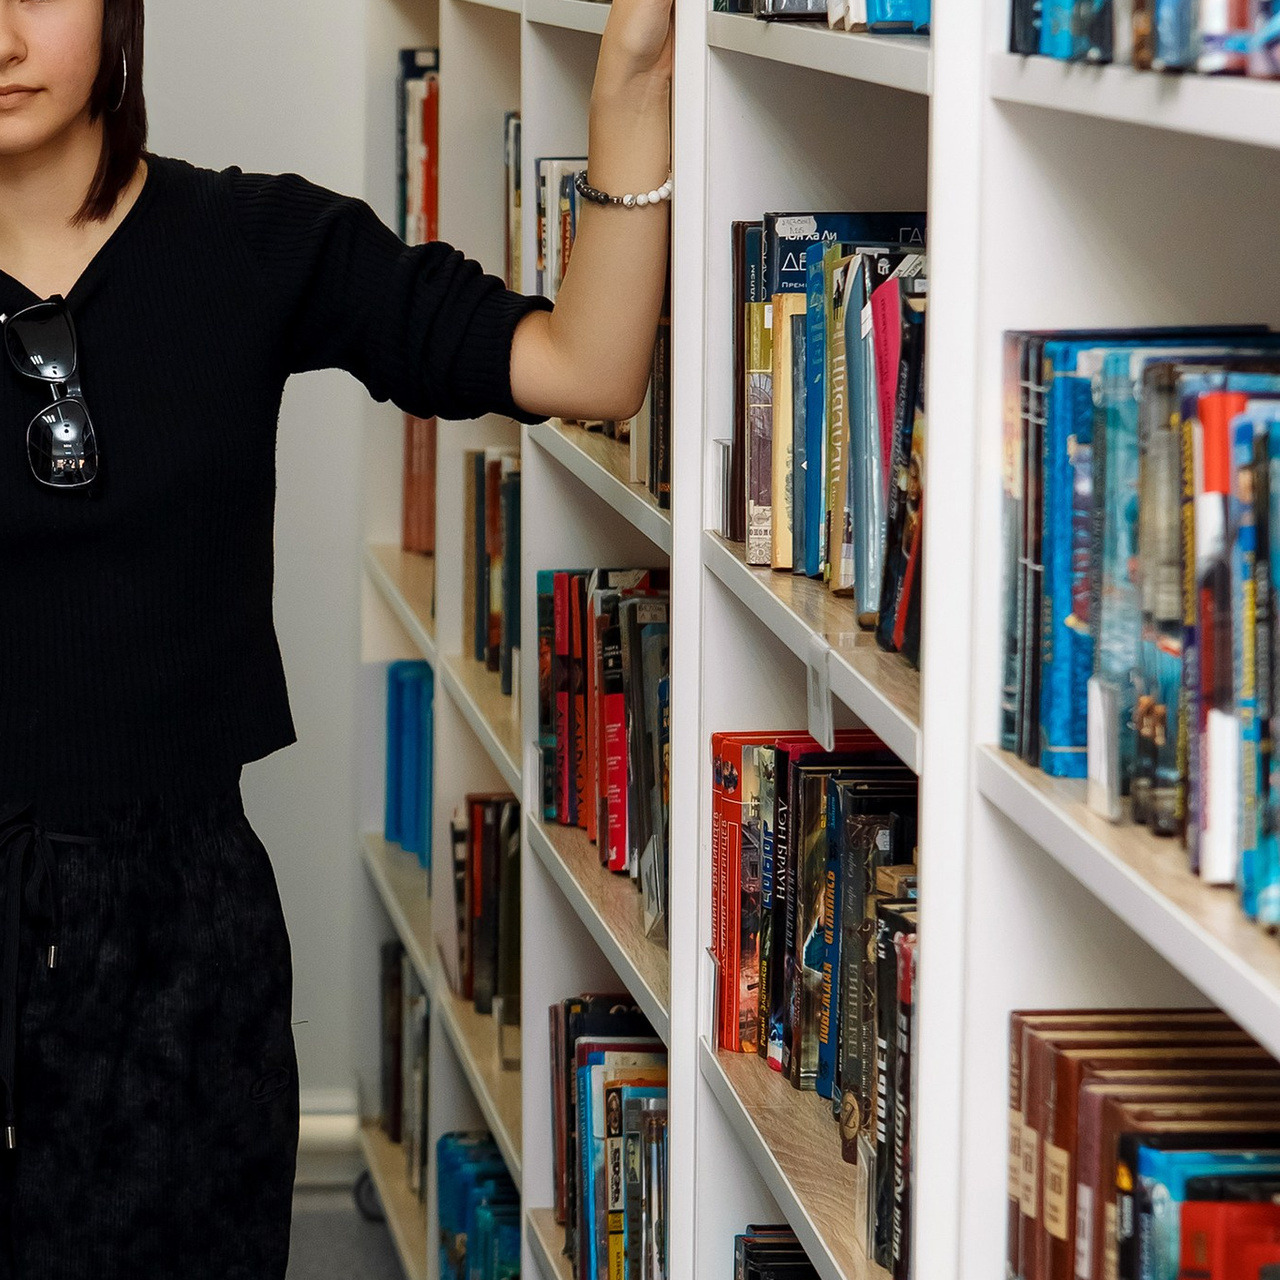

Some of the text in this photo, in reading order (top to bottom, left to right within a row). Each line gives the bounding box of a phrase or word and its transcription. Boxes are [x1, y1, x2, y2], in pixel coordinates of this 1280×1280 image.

[822, 230, 838, 242] Ли
[831, 353, 846, 483] ПЕЛЕВИН
[762, 820, 774, 909] СОБОР
[776, 841, 788, 900] БРАУН
